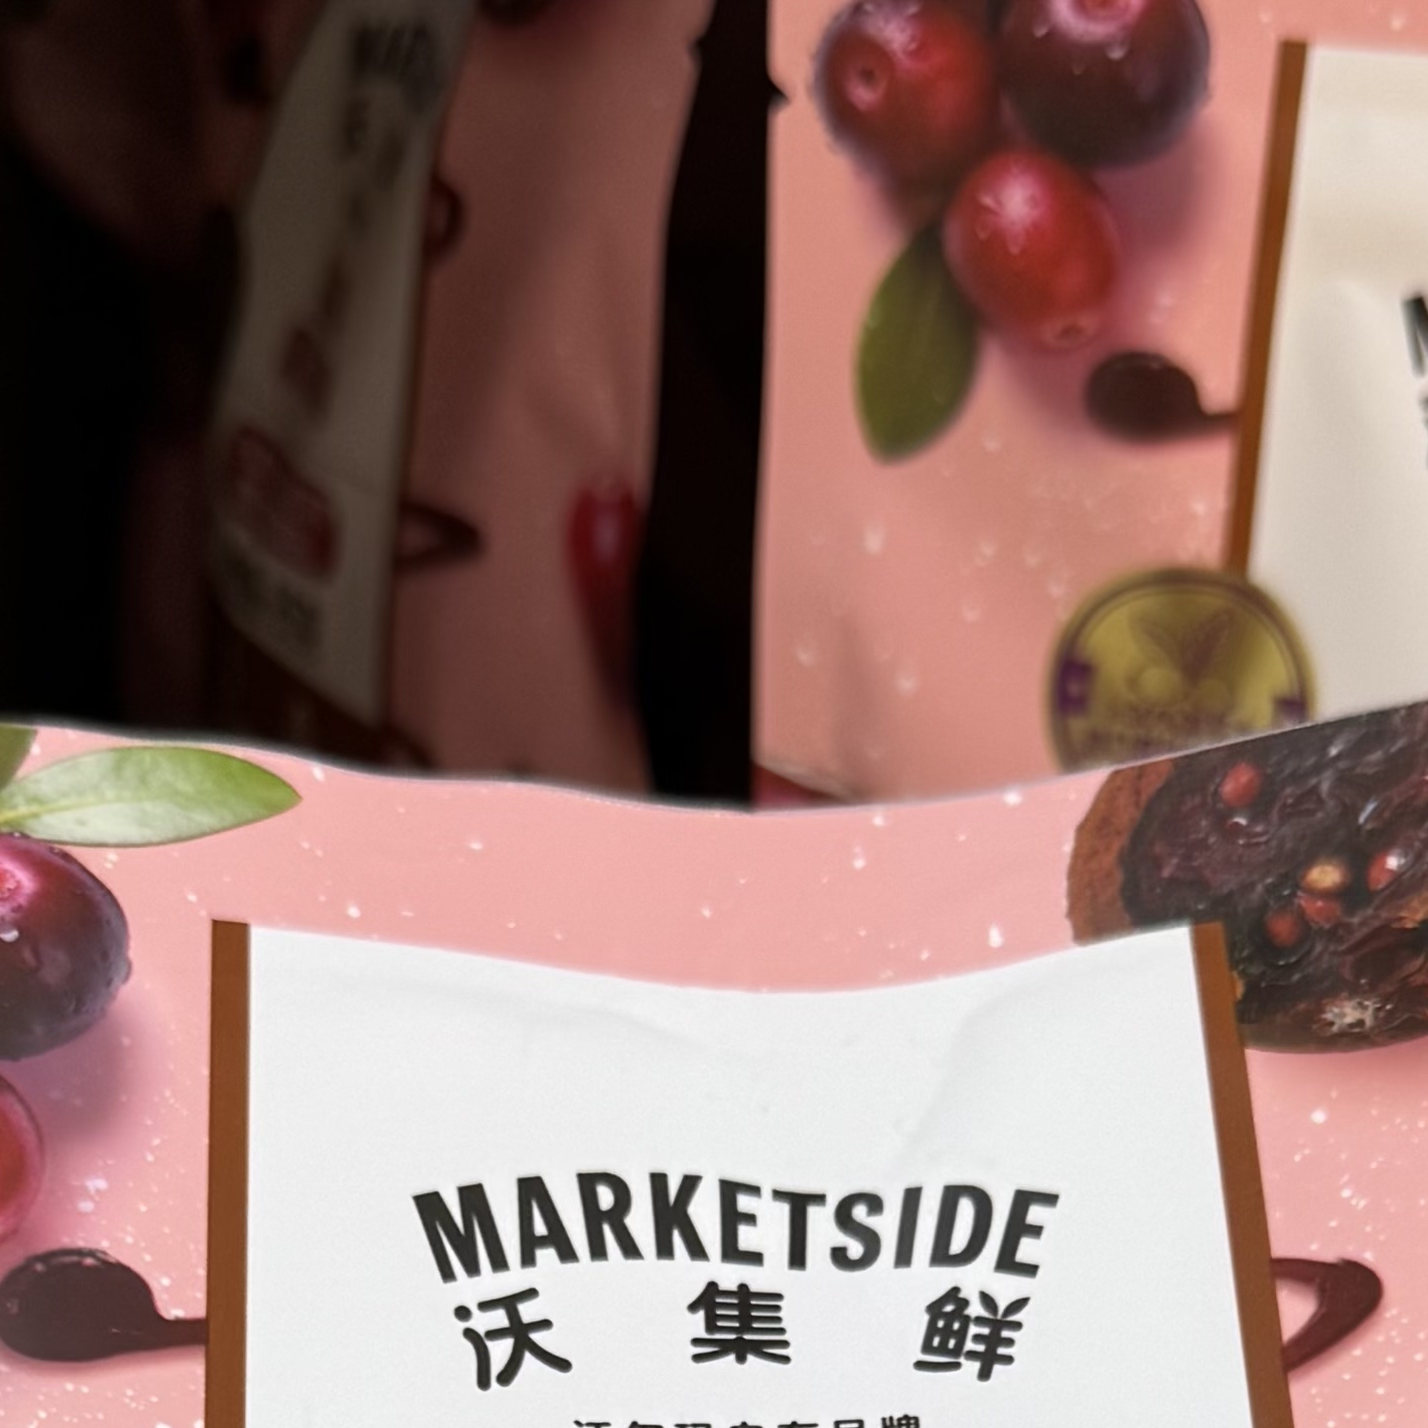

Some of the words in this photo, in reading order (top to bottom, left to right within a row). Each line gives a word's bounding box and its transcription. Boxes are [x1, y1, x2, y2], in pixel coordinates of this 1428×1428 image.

[412, 1171, 1060, 1284] MARKETSIDE
[454, 1281, 1030, 1391] 沃集鲜
